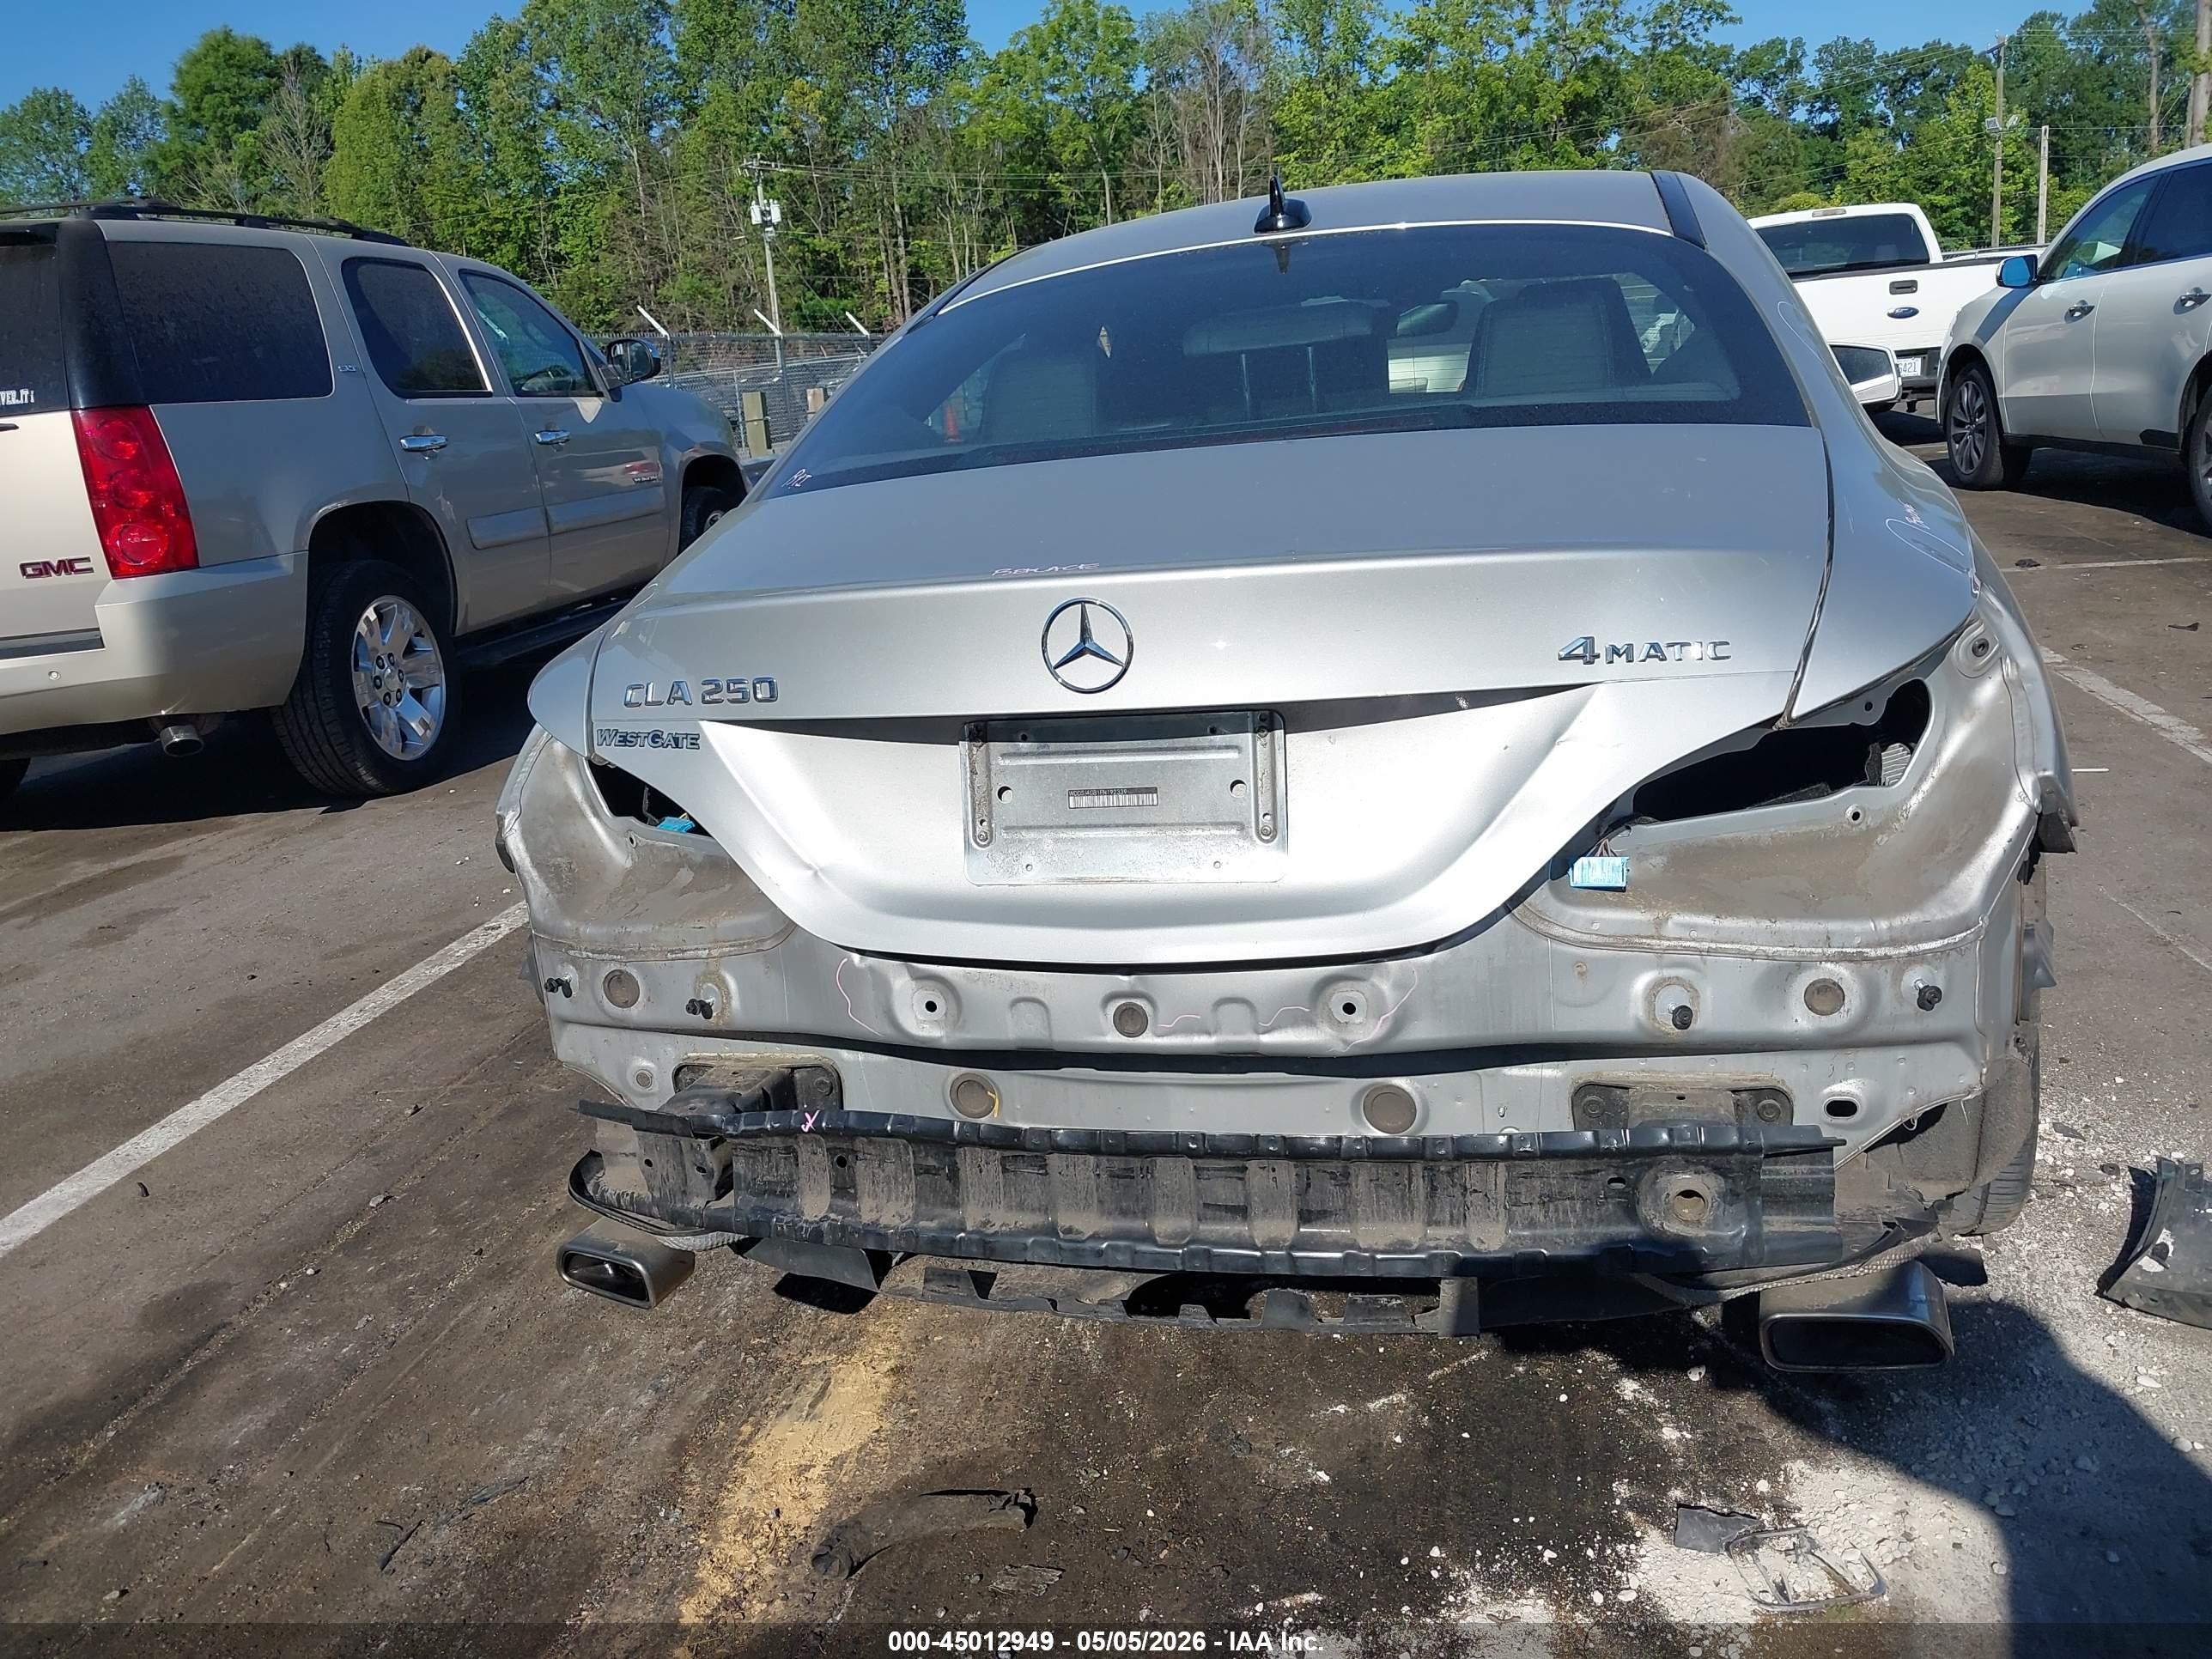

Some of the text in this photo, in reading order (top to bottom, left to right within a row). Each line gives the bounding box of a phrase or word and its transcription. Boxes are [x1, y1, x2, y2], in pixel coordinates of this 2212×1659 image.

[19, 556, 94, 580] GMC
[623, 676, 779, 708] CLA 250
